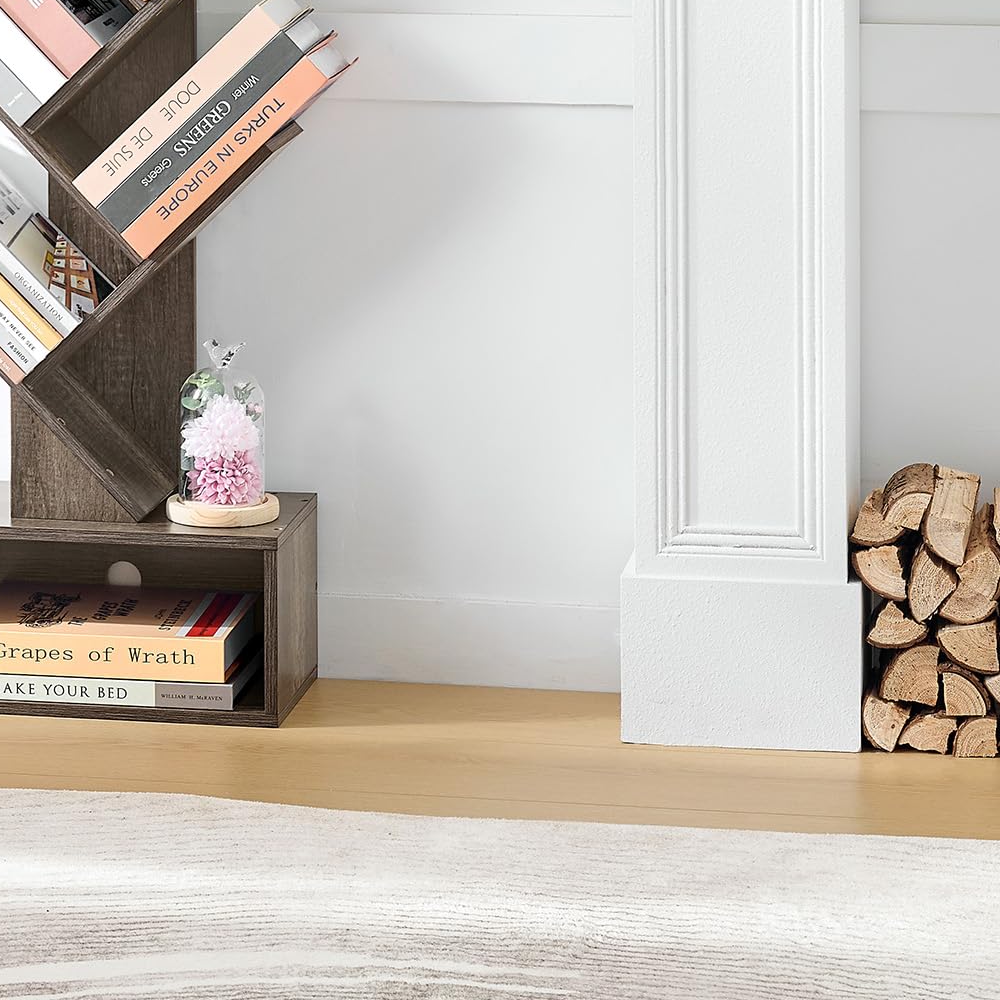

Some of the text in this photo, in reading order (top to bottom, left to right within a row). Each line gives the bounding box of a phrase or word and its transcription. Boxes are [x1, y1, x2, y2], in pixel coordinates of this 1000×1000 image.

[102, 80, 201, 177] DOUE DE SUIE
[141, 75, 259, 186] Winter GREENS Greens
[156, 98, 285, 220] TURKS IN EUROPE
[15, 272, 63, 321] ORGANIZATION
[7, 341, 28, 364] FASHION
[88, 643, 115, 662] of
[129, 646, 196, 665] Wrath
[43, 683, 90, 699] YOUR
[97, 686, 129, 700] BED
